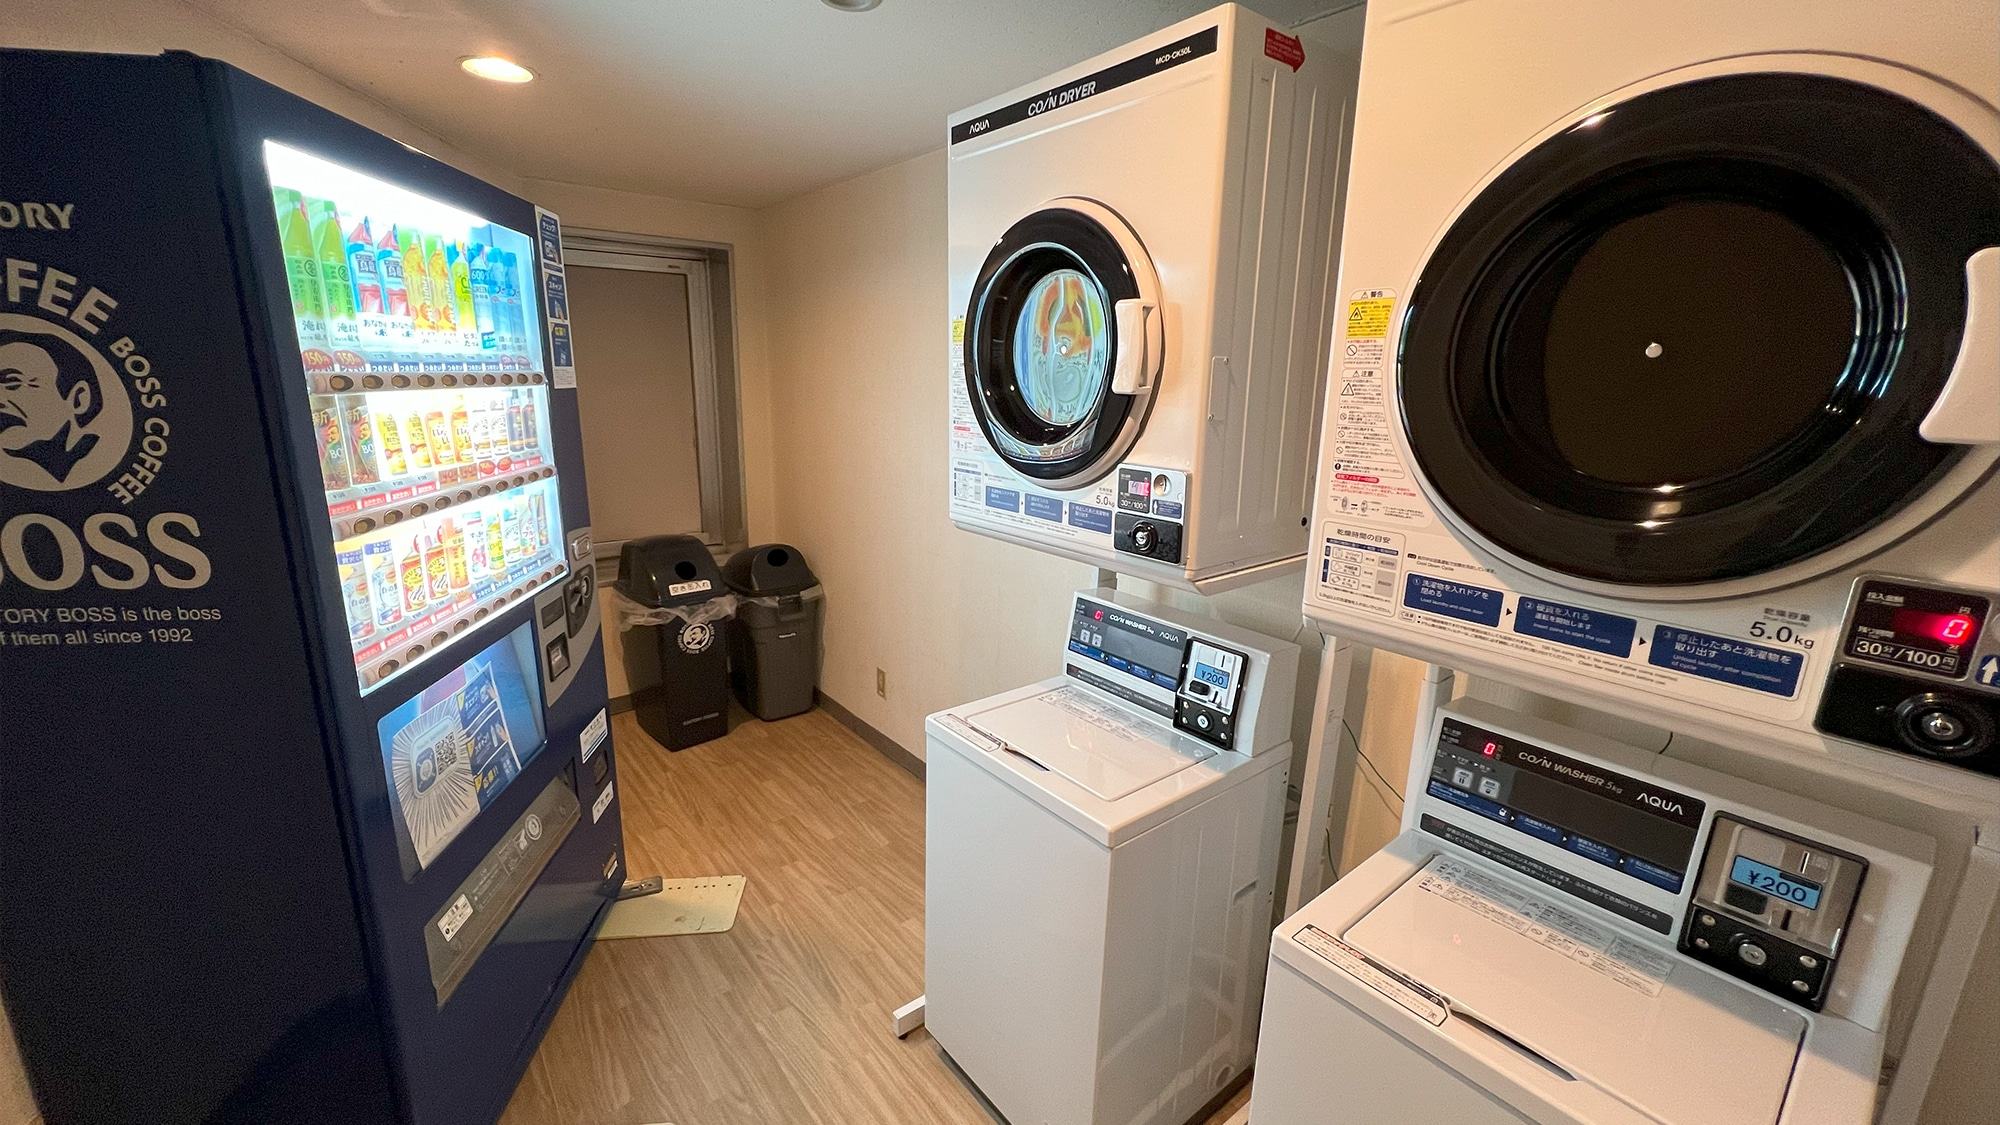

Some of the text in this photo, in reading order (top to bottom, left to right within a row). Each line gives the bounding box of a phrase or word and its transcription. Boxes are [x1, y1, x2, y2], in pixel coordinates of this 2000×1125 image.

[1059, 80, 1096, 106] DRYER
[968, 118, 990, 135] AQUA
[0, 202, 74, 229] ORY
[0, 257, 118, 335] FEE
[107, 336, 170, 505] BOSS COFFEE
[0, 512, 212, 591] OSS
[0, 606, 222, 624] ORY BOSS is the boss
[1125, 619, 1147, 631] WASHER
[1942, 619, 1969, 638] 0
[12, 630, 60, 645] them
[66, 630, 88, 645] all
[93, 628, 142, 643] since
[149, 628, 194, 643] 1992
[1159, 631, 1179, 643] AQUA
[1674, 643, 1718, 659] 取り出す
[1201, 669, 1224, 686] ¥200
[1483, 742, 1496, 755] 0
[1553, 762, 1604, 786] WASHER
[1637, 792, 1684, 815] AQUA
[1748, 870, 1807, 902] ¥200
